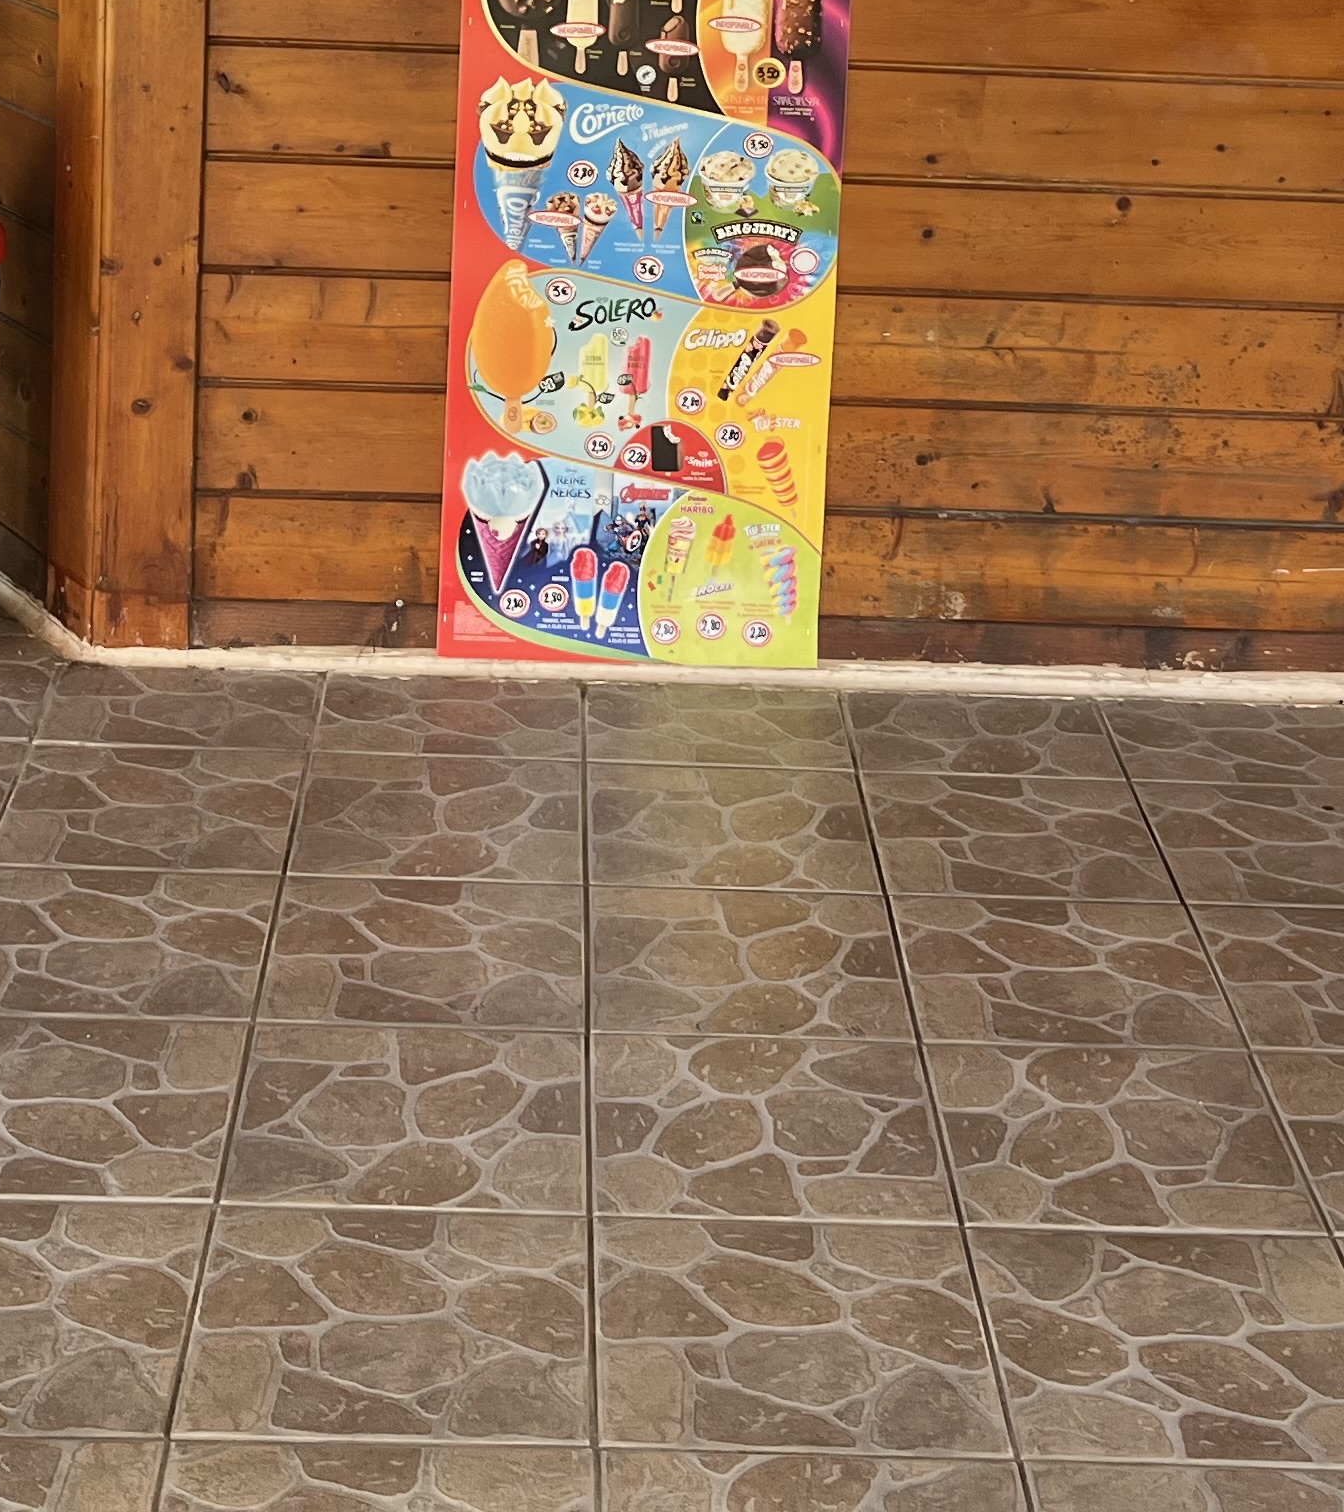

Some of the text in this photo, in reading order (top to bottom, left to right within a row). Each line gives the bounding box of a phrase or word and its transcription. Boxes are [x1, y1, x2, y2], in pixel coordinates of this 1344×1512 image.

[569, 102, 644, 145] Cornetto
[568, 296, 656, 332] SOLERO
[684, 328, 747, 351] Calippo
[556, 476, 586, 486] REINE
[550, 488, 592, 500] NEIGES
[680, 506, 714, 514] HARIBO
